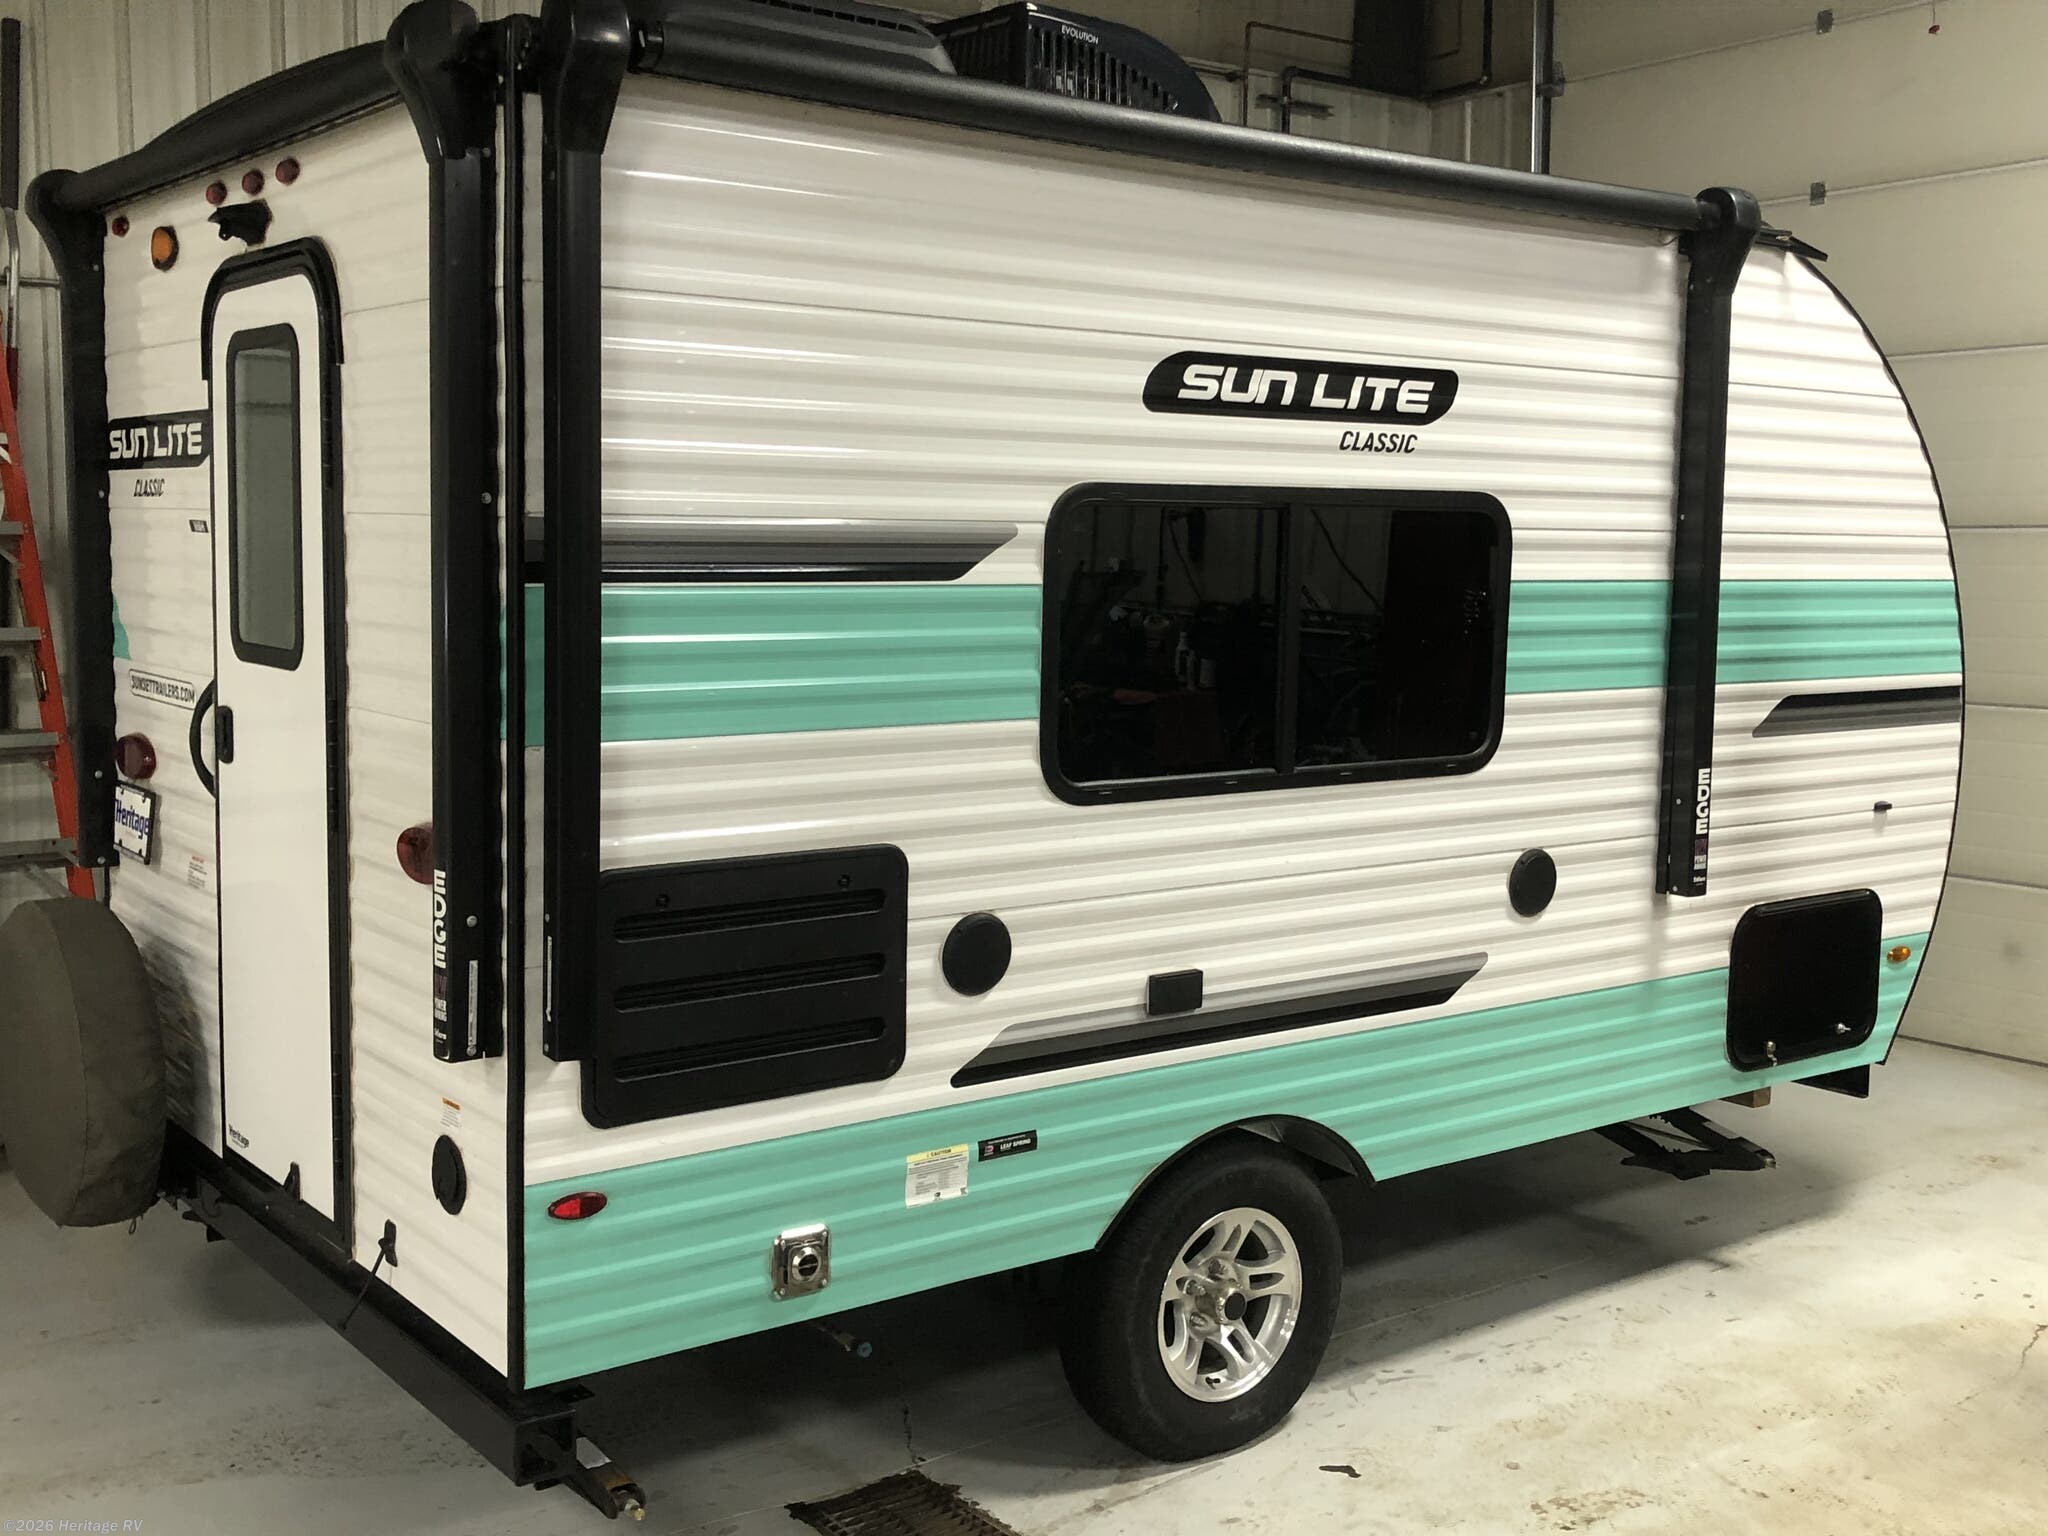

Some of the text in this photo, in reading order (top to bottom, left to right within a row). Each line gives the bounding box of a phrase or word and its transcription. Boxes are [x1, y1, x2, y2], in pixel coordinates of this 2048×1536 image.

[1061, 25, 1099, 44] EVOLUTION
[1177, 364, 1435, 413] SUN LITE
[109, 422, 203, 460] SUN LITE
[1338, 430, 1418, 454] CLASSIC
[133, 478, 166, 498] CLASSIC
[131, 675, 195, 703] SUNSETTRAILERS.COM
[115, 799, 150, 840] Heritage
[1695, 768, 1711, 835] EDGE
[433, 868, 448, 970] EDGE
